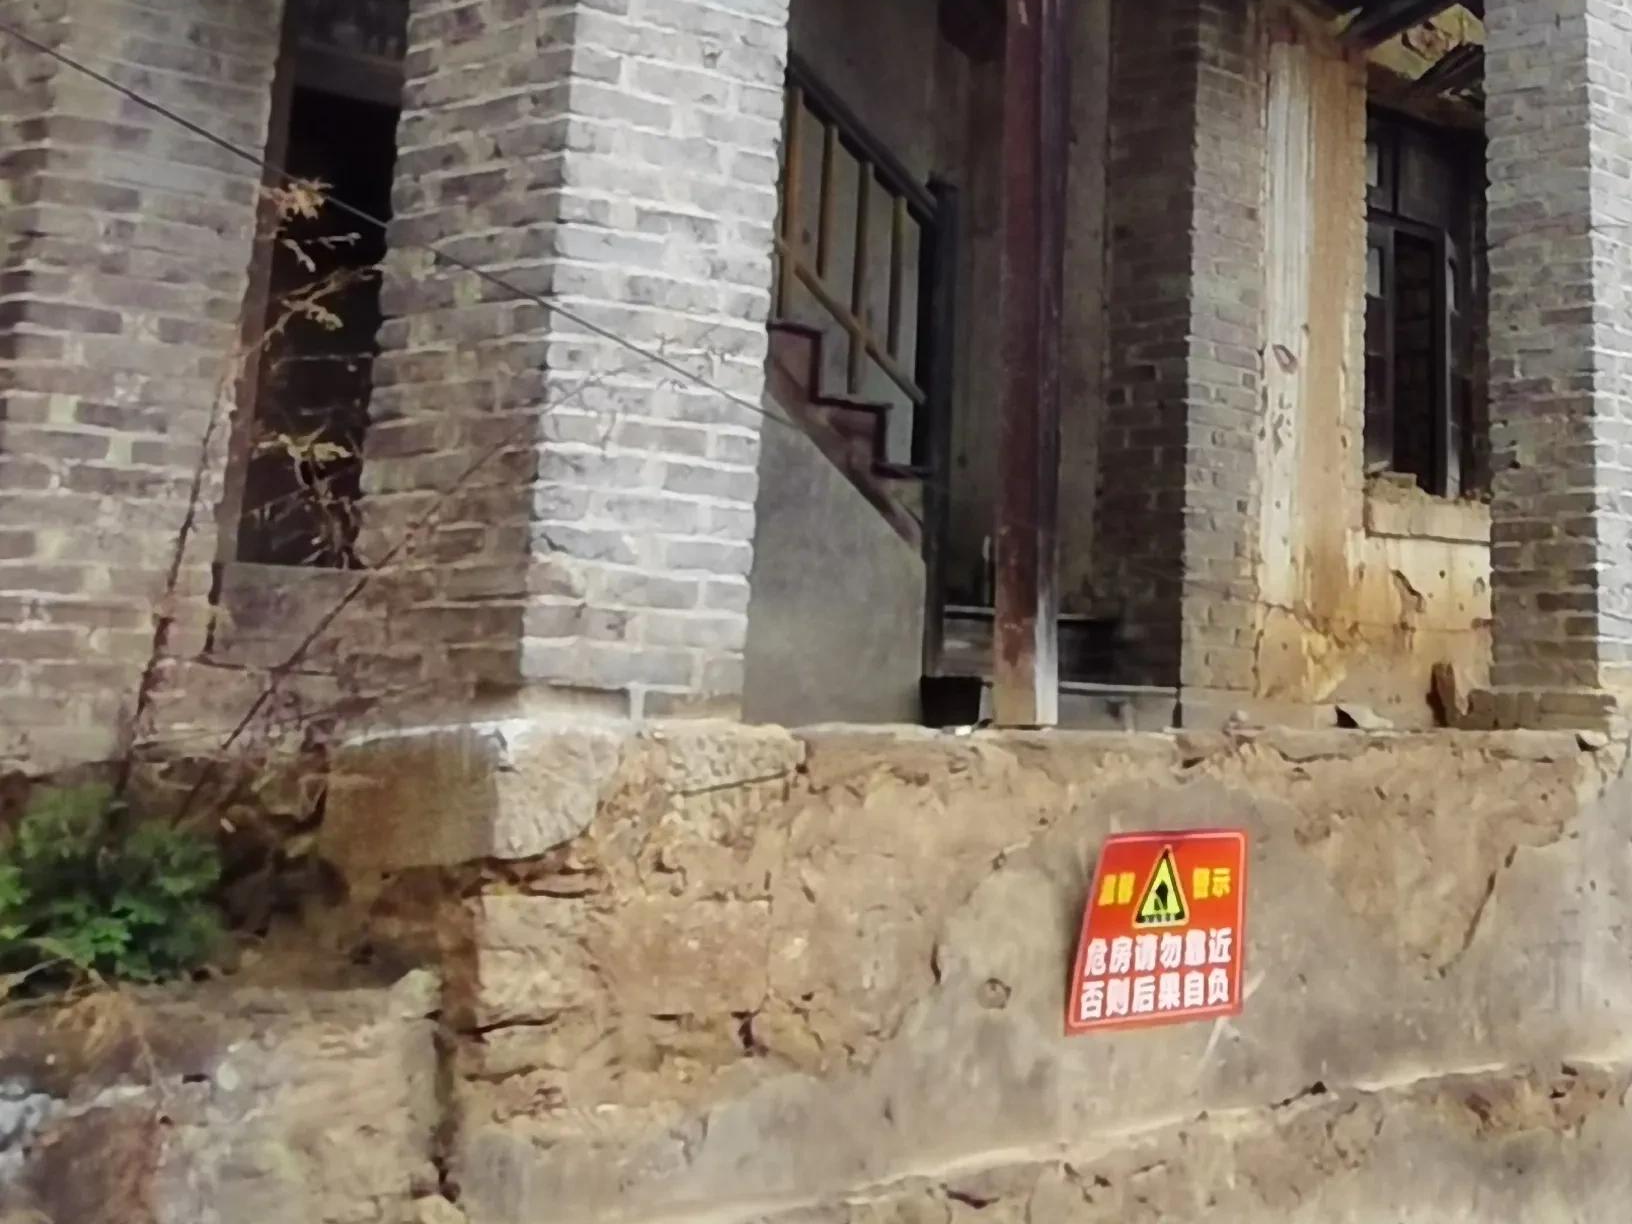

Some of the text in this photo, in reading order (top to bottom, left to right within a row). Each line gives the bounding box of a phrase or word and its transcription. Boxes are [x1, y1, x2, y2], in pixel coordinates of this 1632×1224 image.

[1085, 927, 1232, 976] 危房请勿靠近
[1080, 968, 1229, 1020] 否则后果自负
